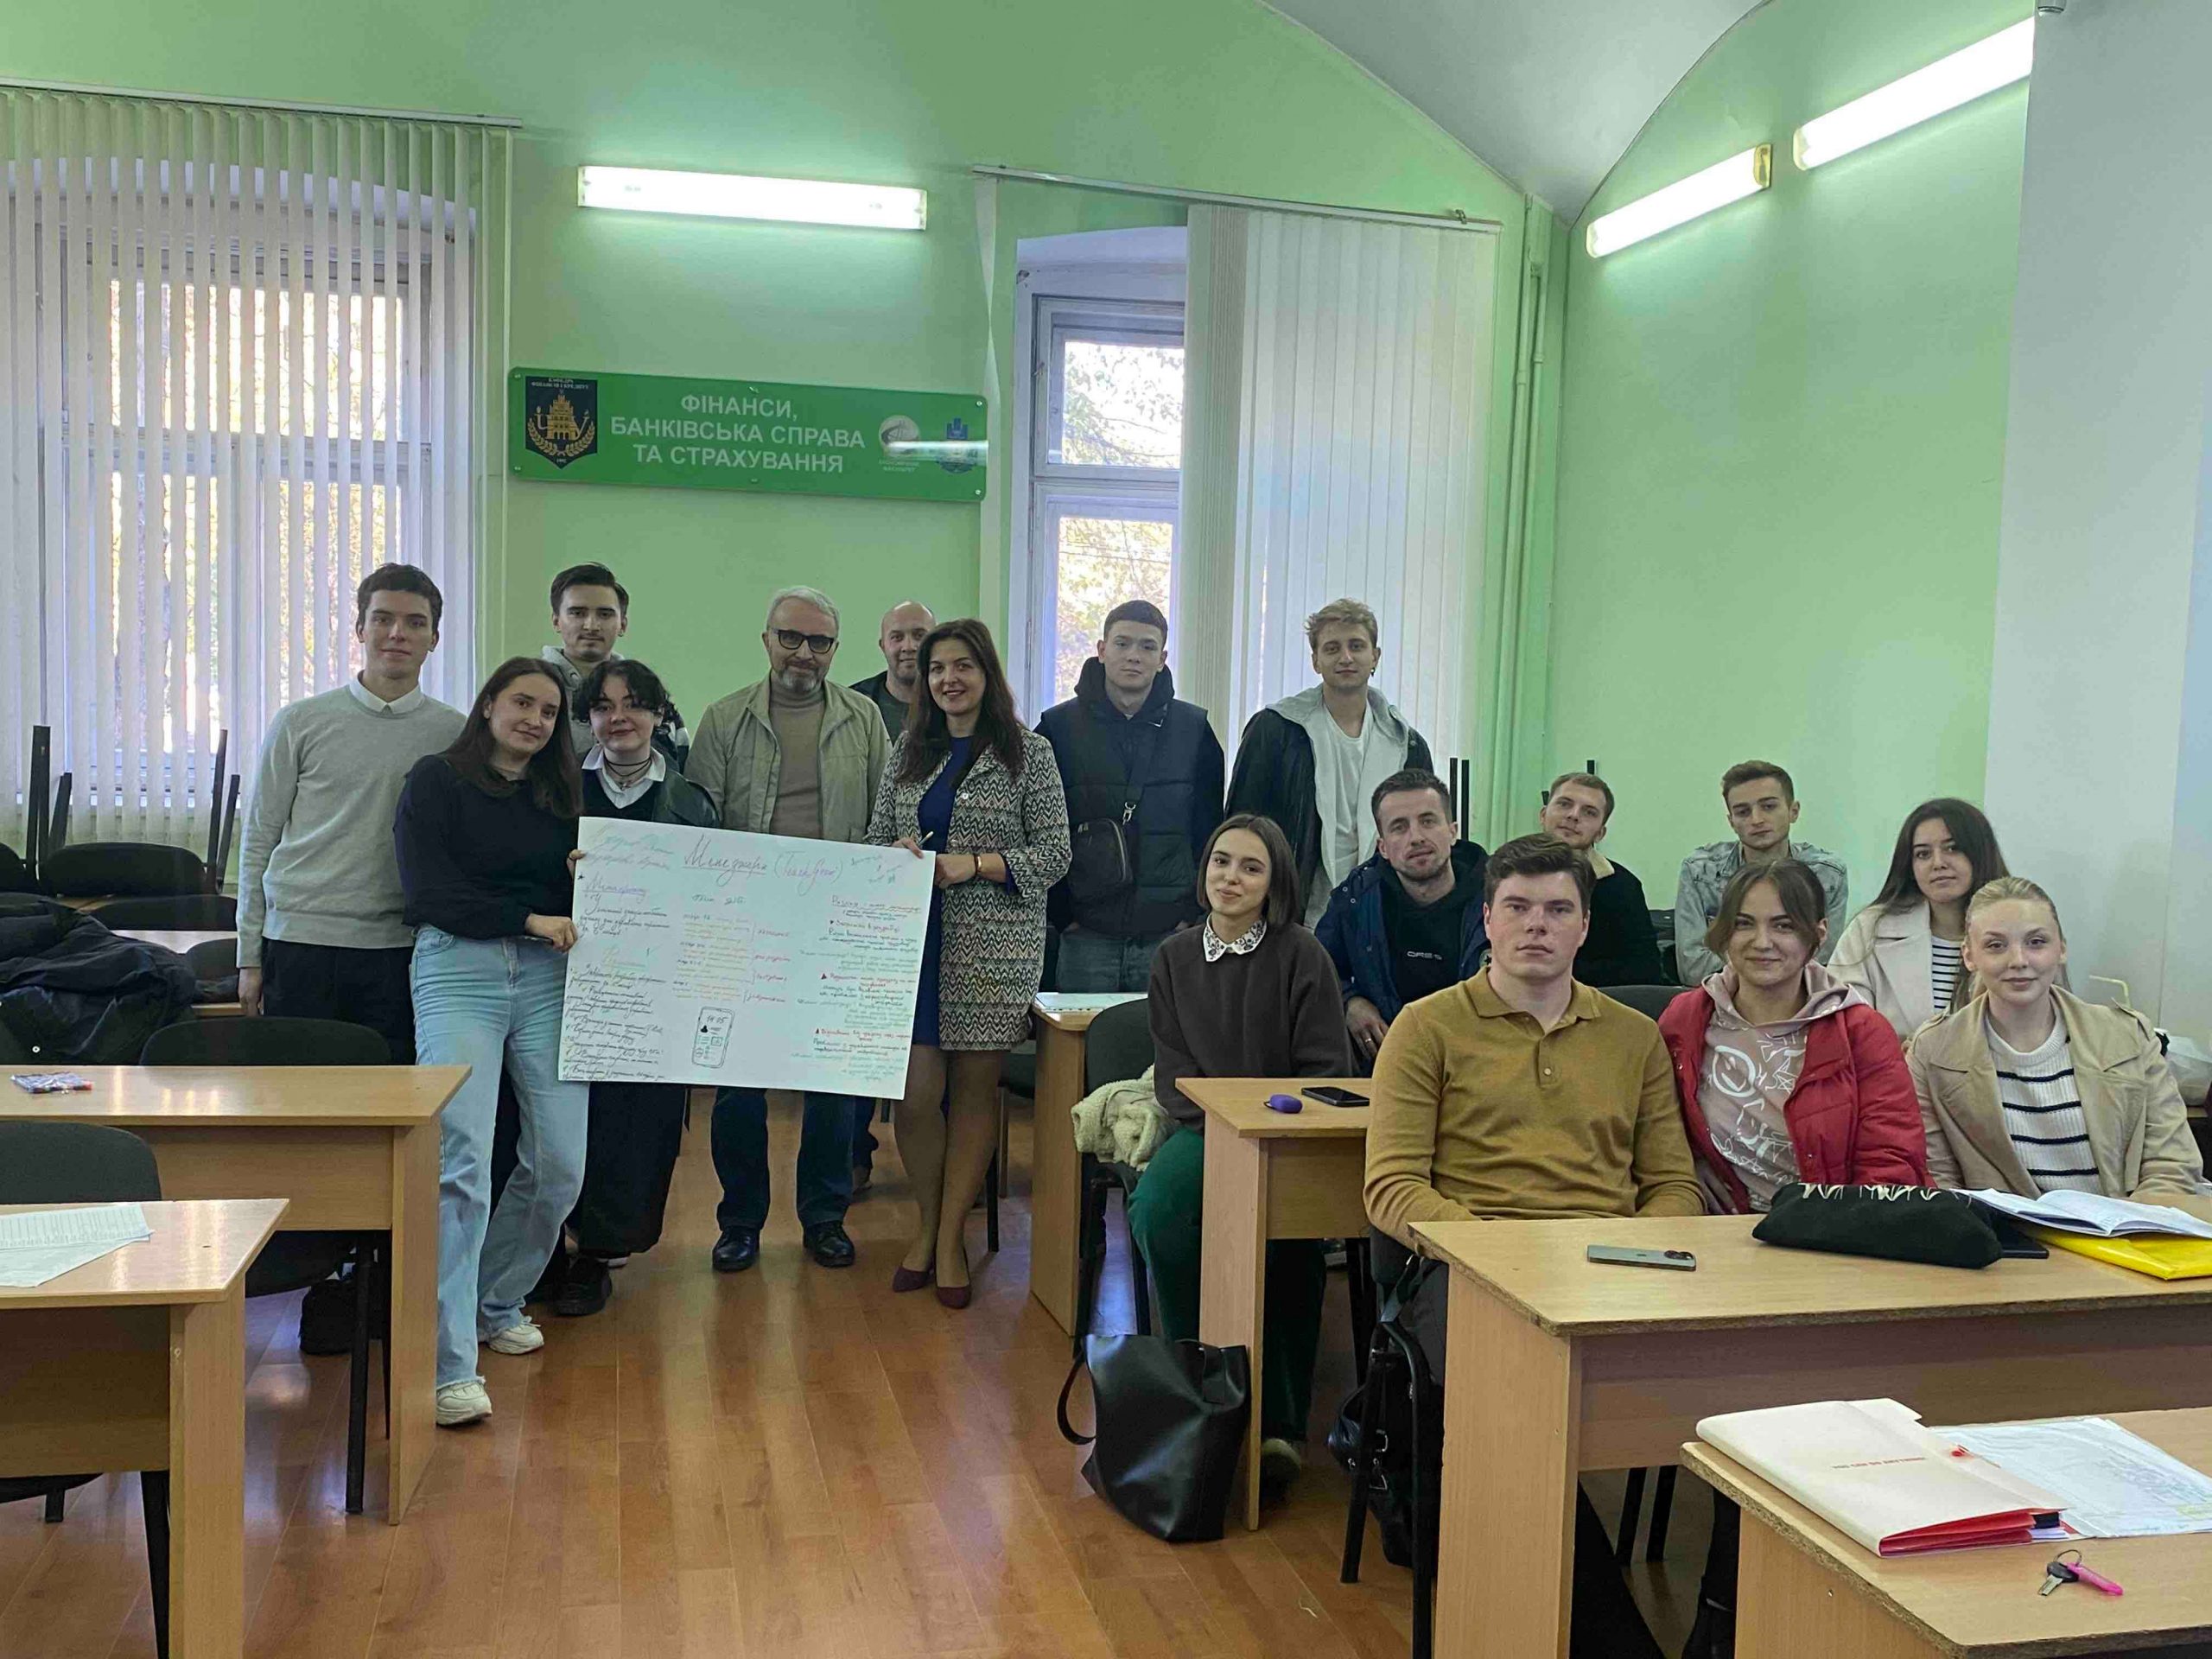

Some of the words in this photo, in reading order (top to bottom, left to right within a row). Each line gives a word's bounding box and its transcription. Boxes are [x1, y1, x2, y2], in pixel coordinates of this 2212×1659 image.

[681, 394, 798, 420] ФІНАНСИ,
[611, 416, 764, 442] БАНКІВСЬКА
[771, 427, 866, 448] СПРАВА
[633, 444, 664, 463] ТА
[670, 447, 843, 473] СТРАХУВАННЯ
